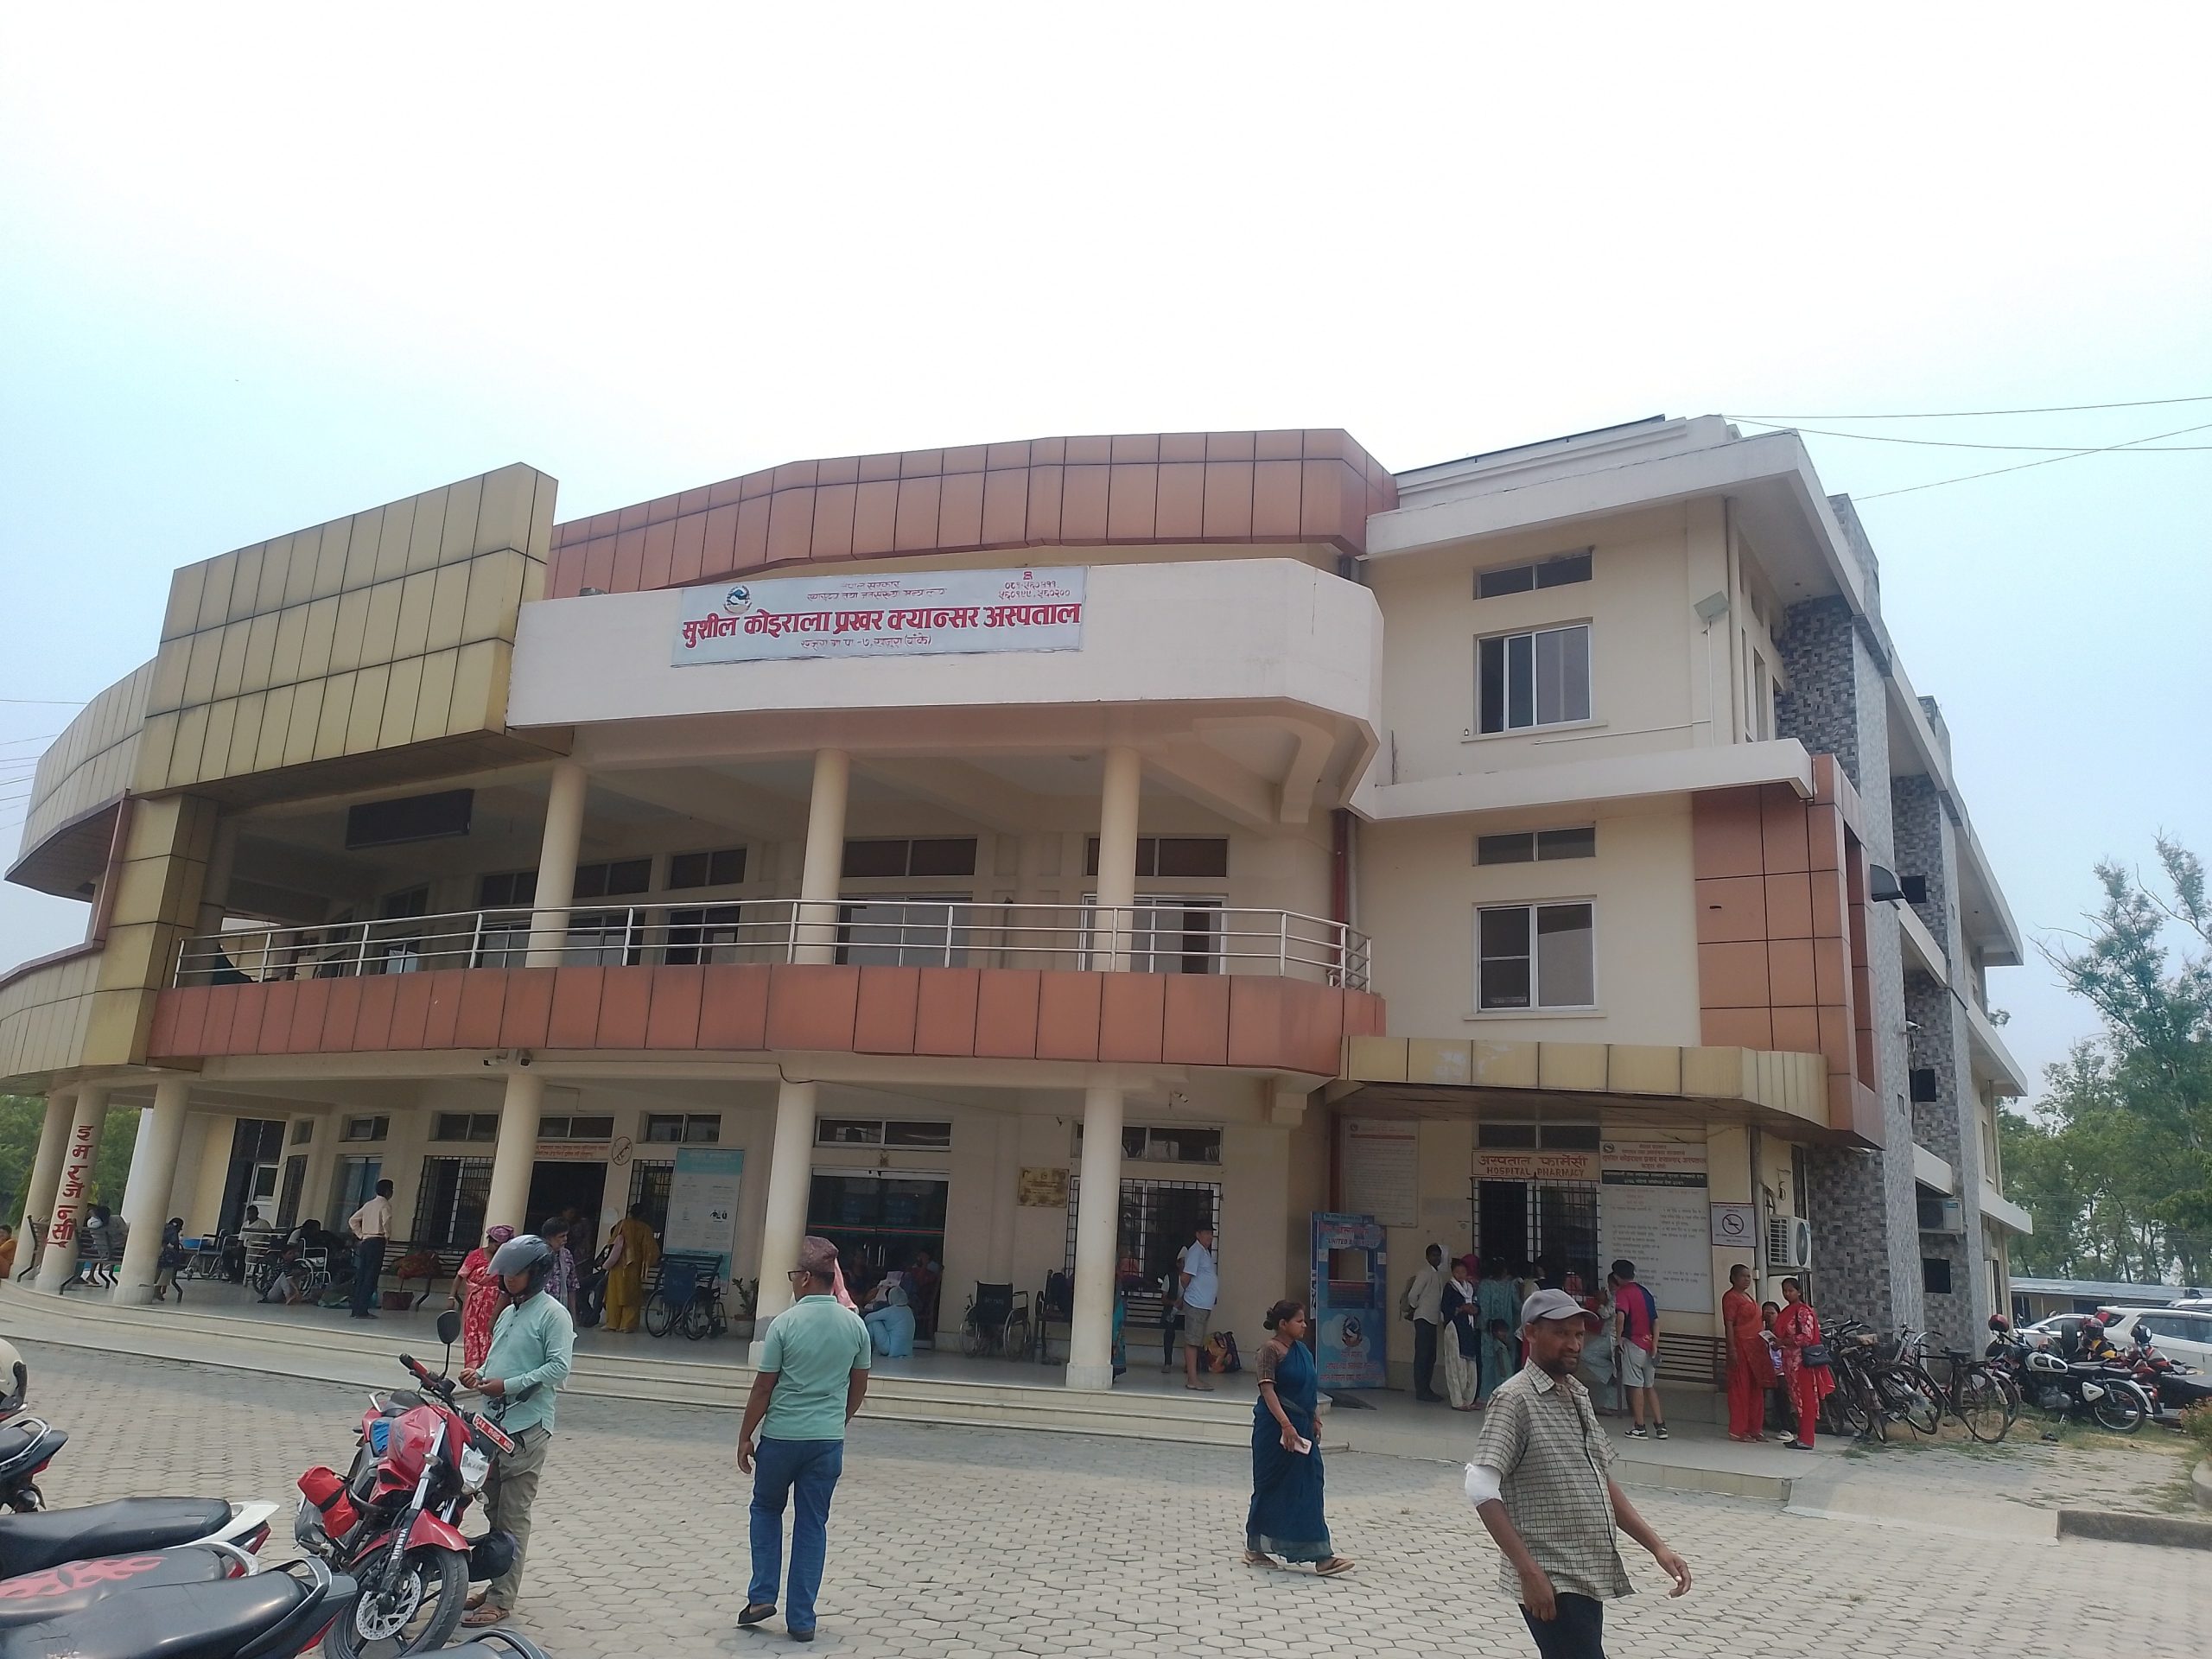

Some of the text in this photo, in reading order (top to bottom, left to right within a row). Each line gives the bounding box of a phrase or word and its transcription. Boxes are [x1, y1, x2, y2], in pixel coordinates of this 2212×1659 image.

[682, 603, 1083, 649] सुशील कोइराला प्रखर क्यान्सर अस्पताल
[1486, 1166, 1585, 1177] HOSPITAL PHARMACY
[391, 1528, 409, 1560] YAMAHA
